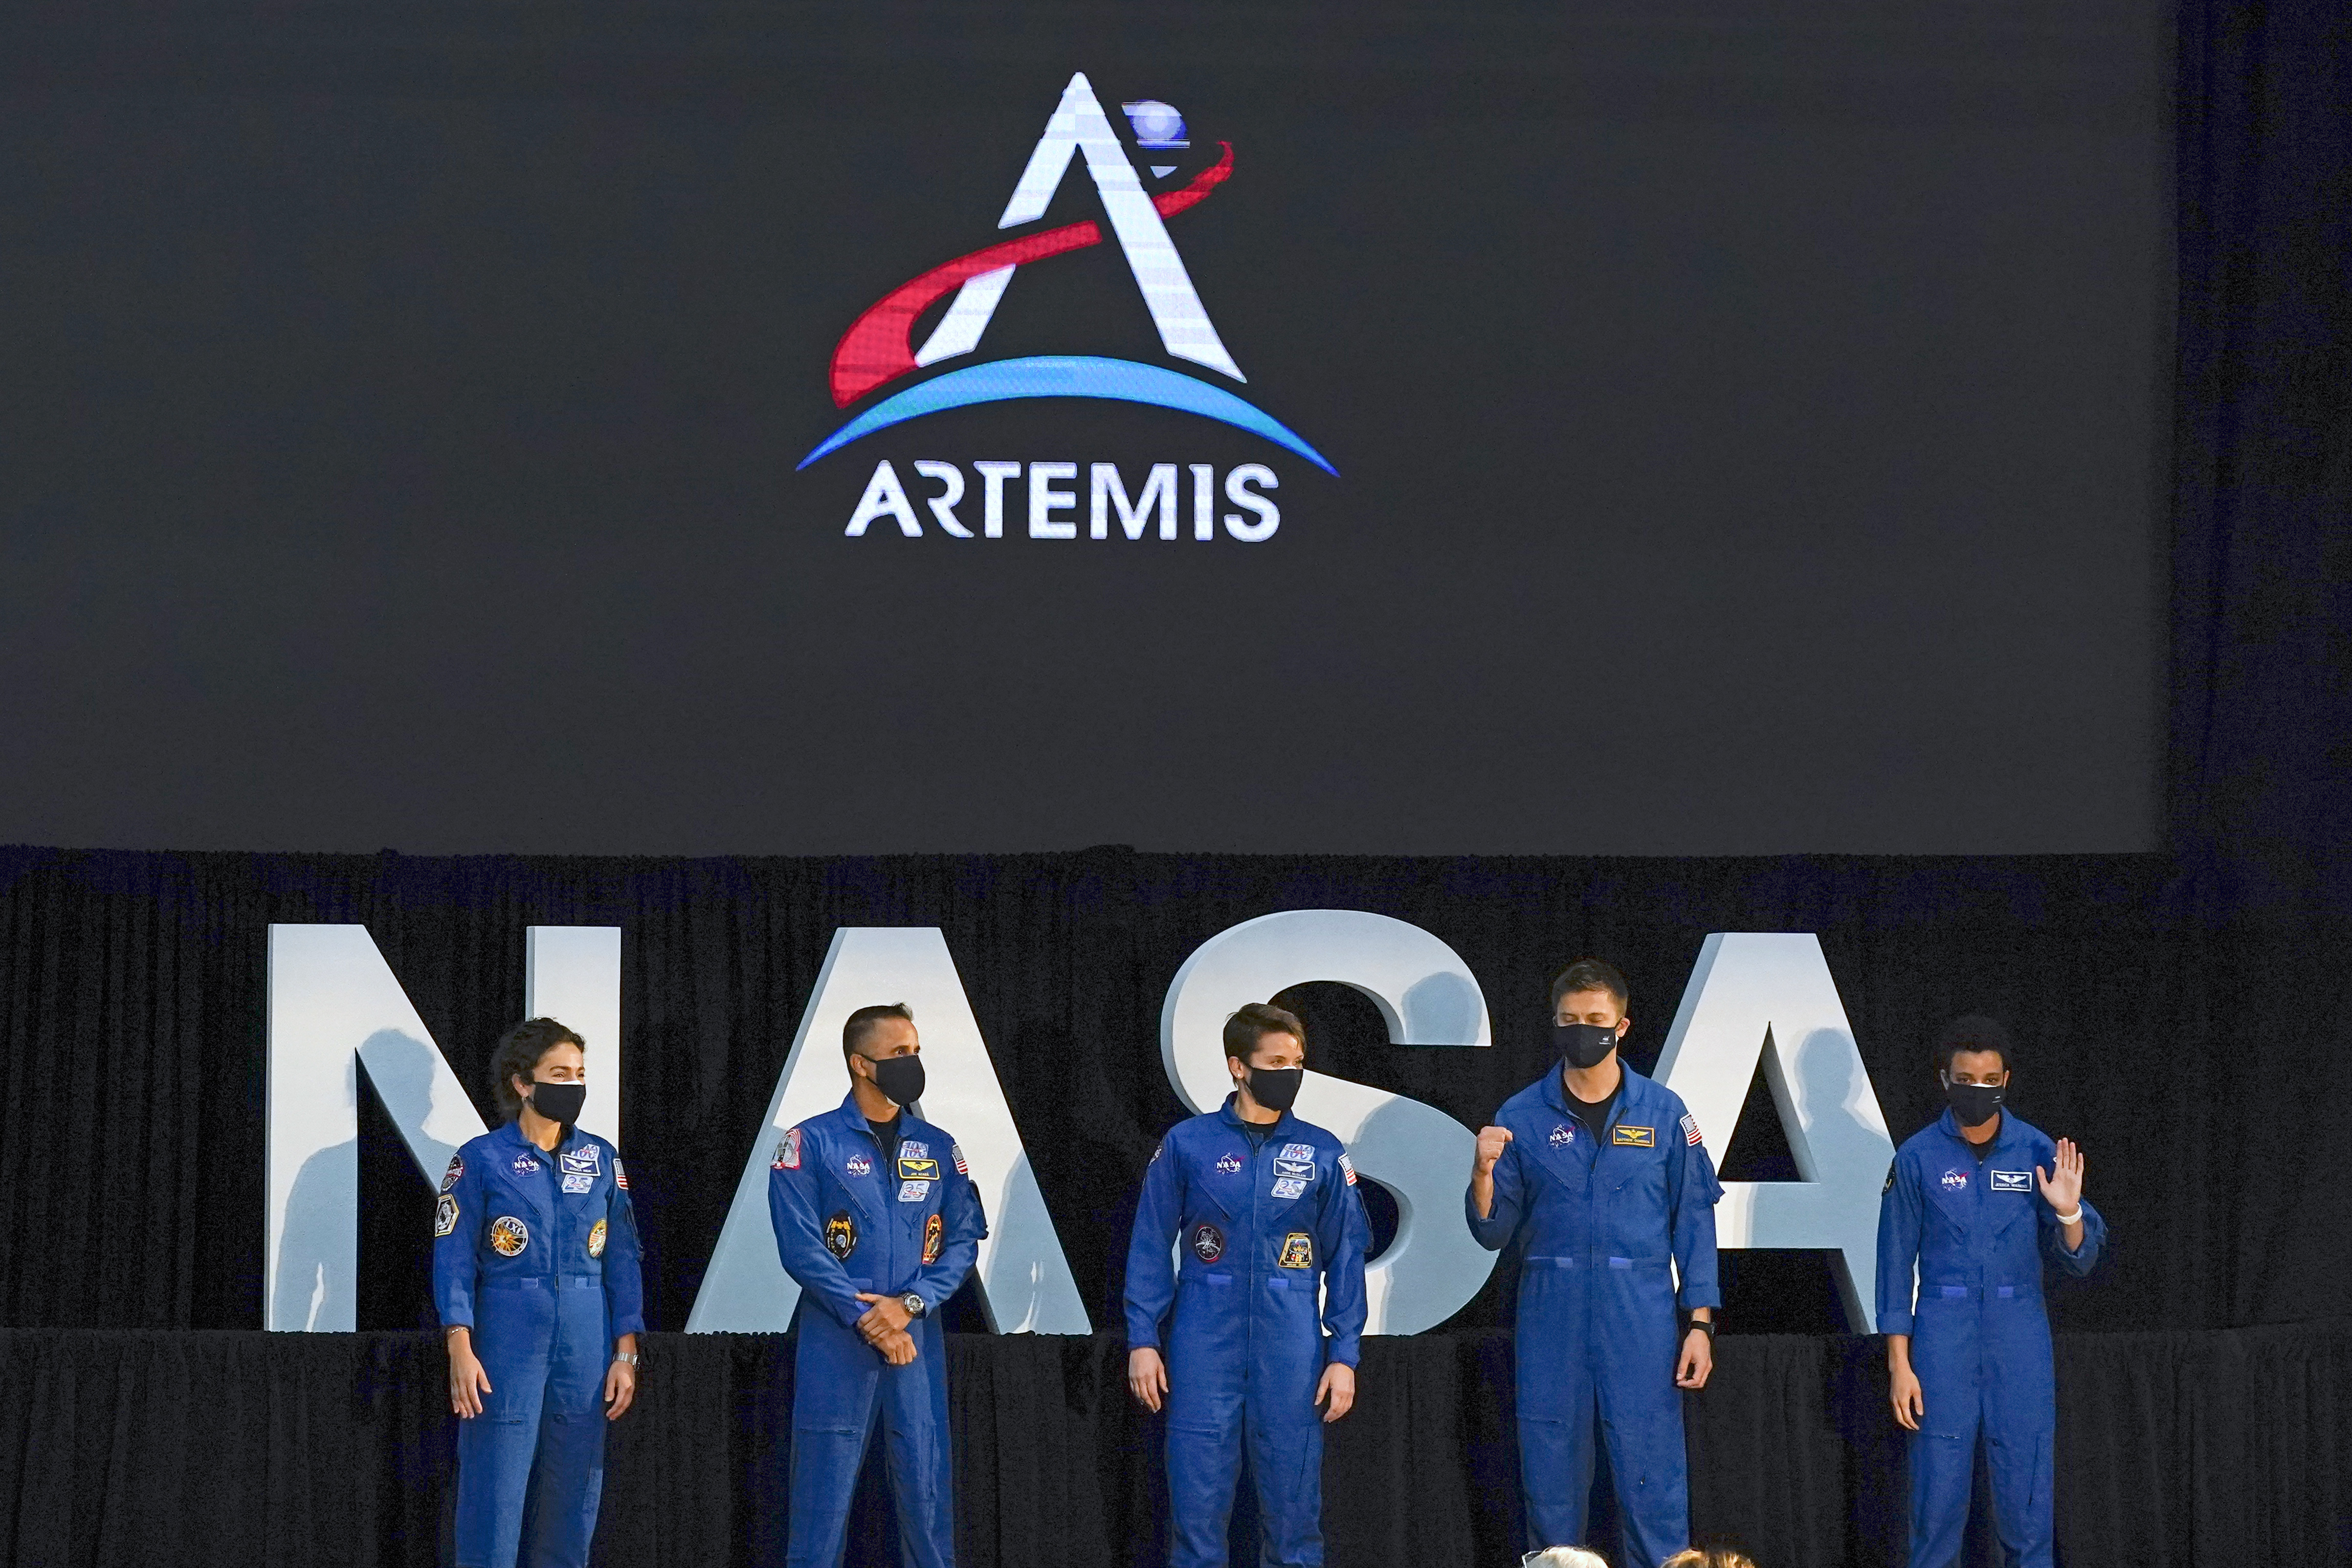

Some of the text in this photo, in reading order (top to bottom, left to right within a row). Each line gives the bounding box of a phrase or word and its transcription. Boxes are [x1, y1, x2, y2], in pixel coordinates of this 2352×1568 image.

[845, 459, 1280, 542] ARTEMIS
[263, 909, 1896, 1336] NASA
[1549, 1131, 1573, 1141] NASA
[1942, 1176, 1967, 1185] NASA
[902, 1183, 925, 1199] 25
[505, 1220, 521, 1235] LXI
